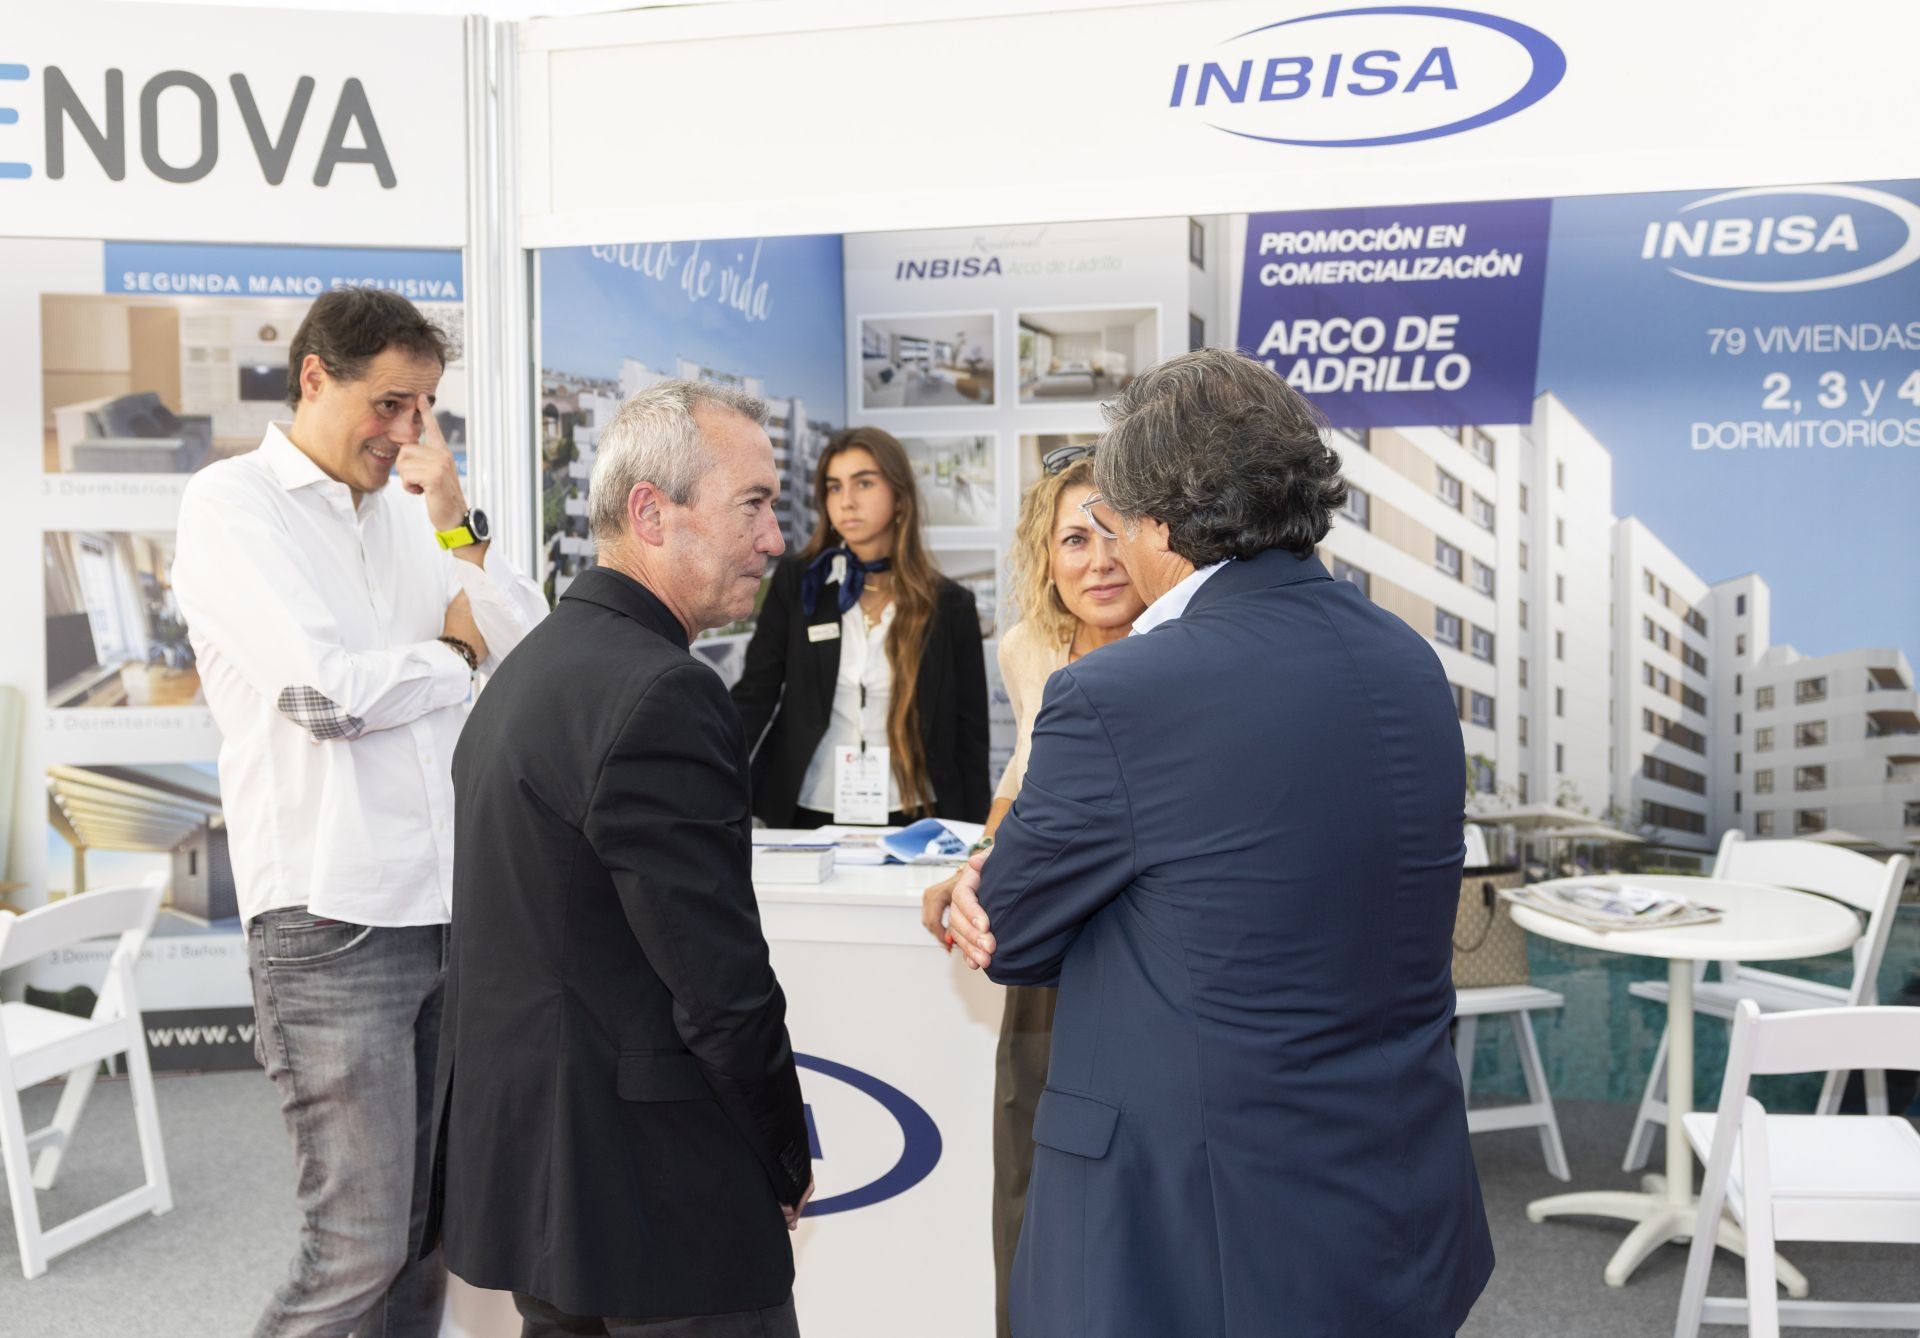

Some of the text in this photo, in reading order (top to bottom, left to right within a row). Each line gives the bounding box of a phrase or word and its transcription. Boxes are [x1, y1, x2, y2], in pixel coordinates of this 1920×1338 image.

[1169, 47, 1460, 108] INBISA
[1258, 222, 1467, 255] PROMOCIÓN EN
[1641, 213, 1860, 259] INBISA
[123, 271, 241, 293] SEGUNDA
[249, 275, 323, 294] MANO
[896, 256, 1004, 281] INBISA
[1259, 249, 1523, 287] COMERCIALIZACIÓN
[1257, 314, 1460, 355] ARCO DE
[1706, 321, 1920, 356] 79 VIVIENDAS
[1264, 352, 1472, 393] ADRILLO
[1761, 368, 1920, 417] 2, 3 y 4
[1690, 417, 1920, 451] DORMITORIOS
